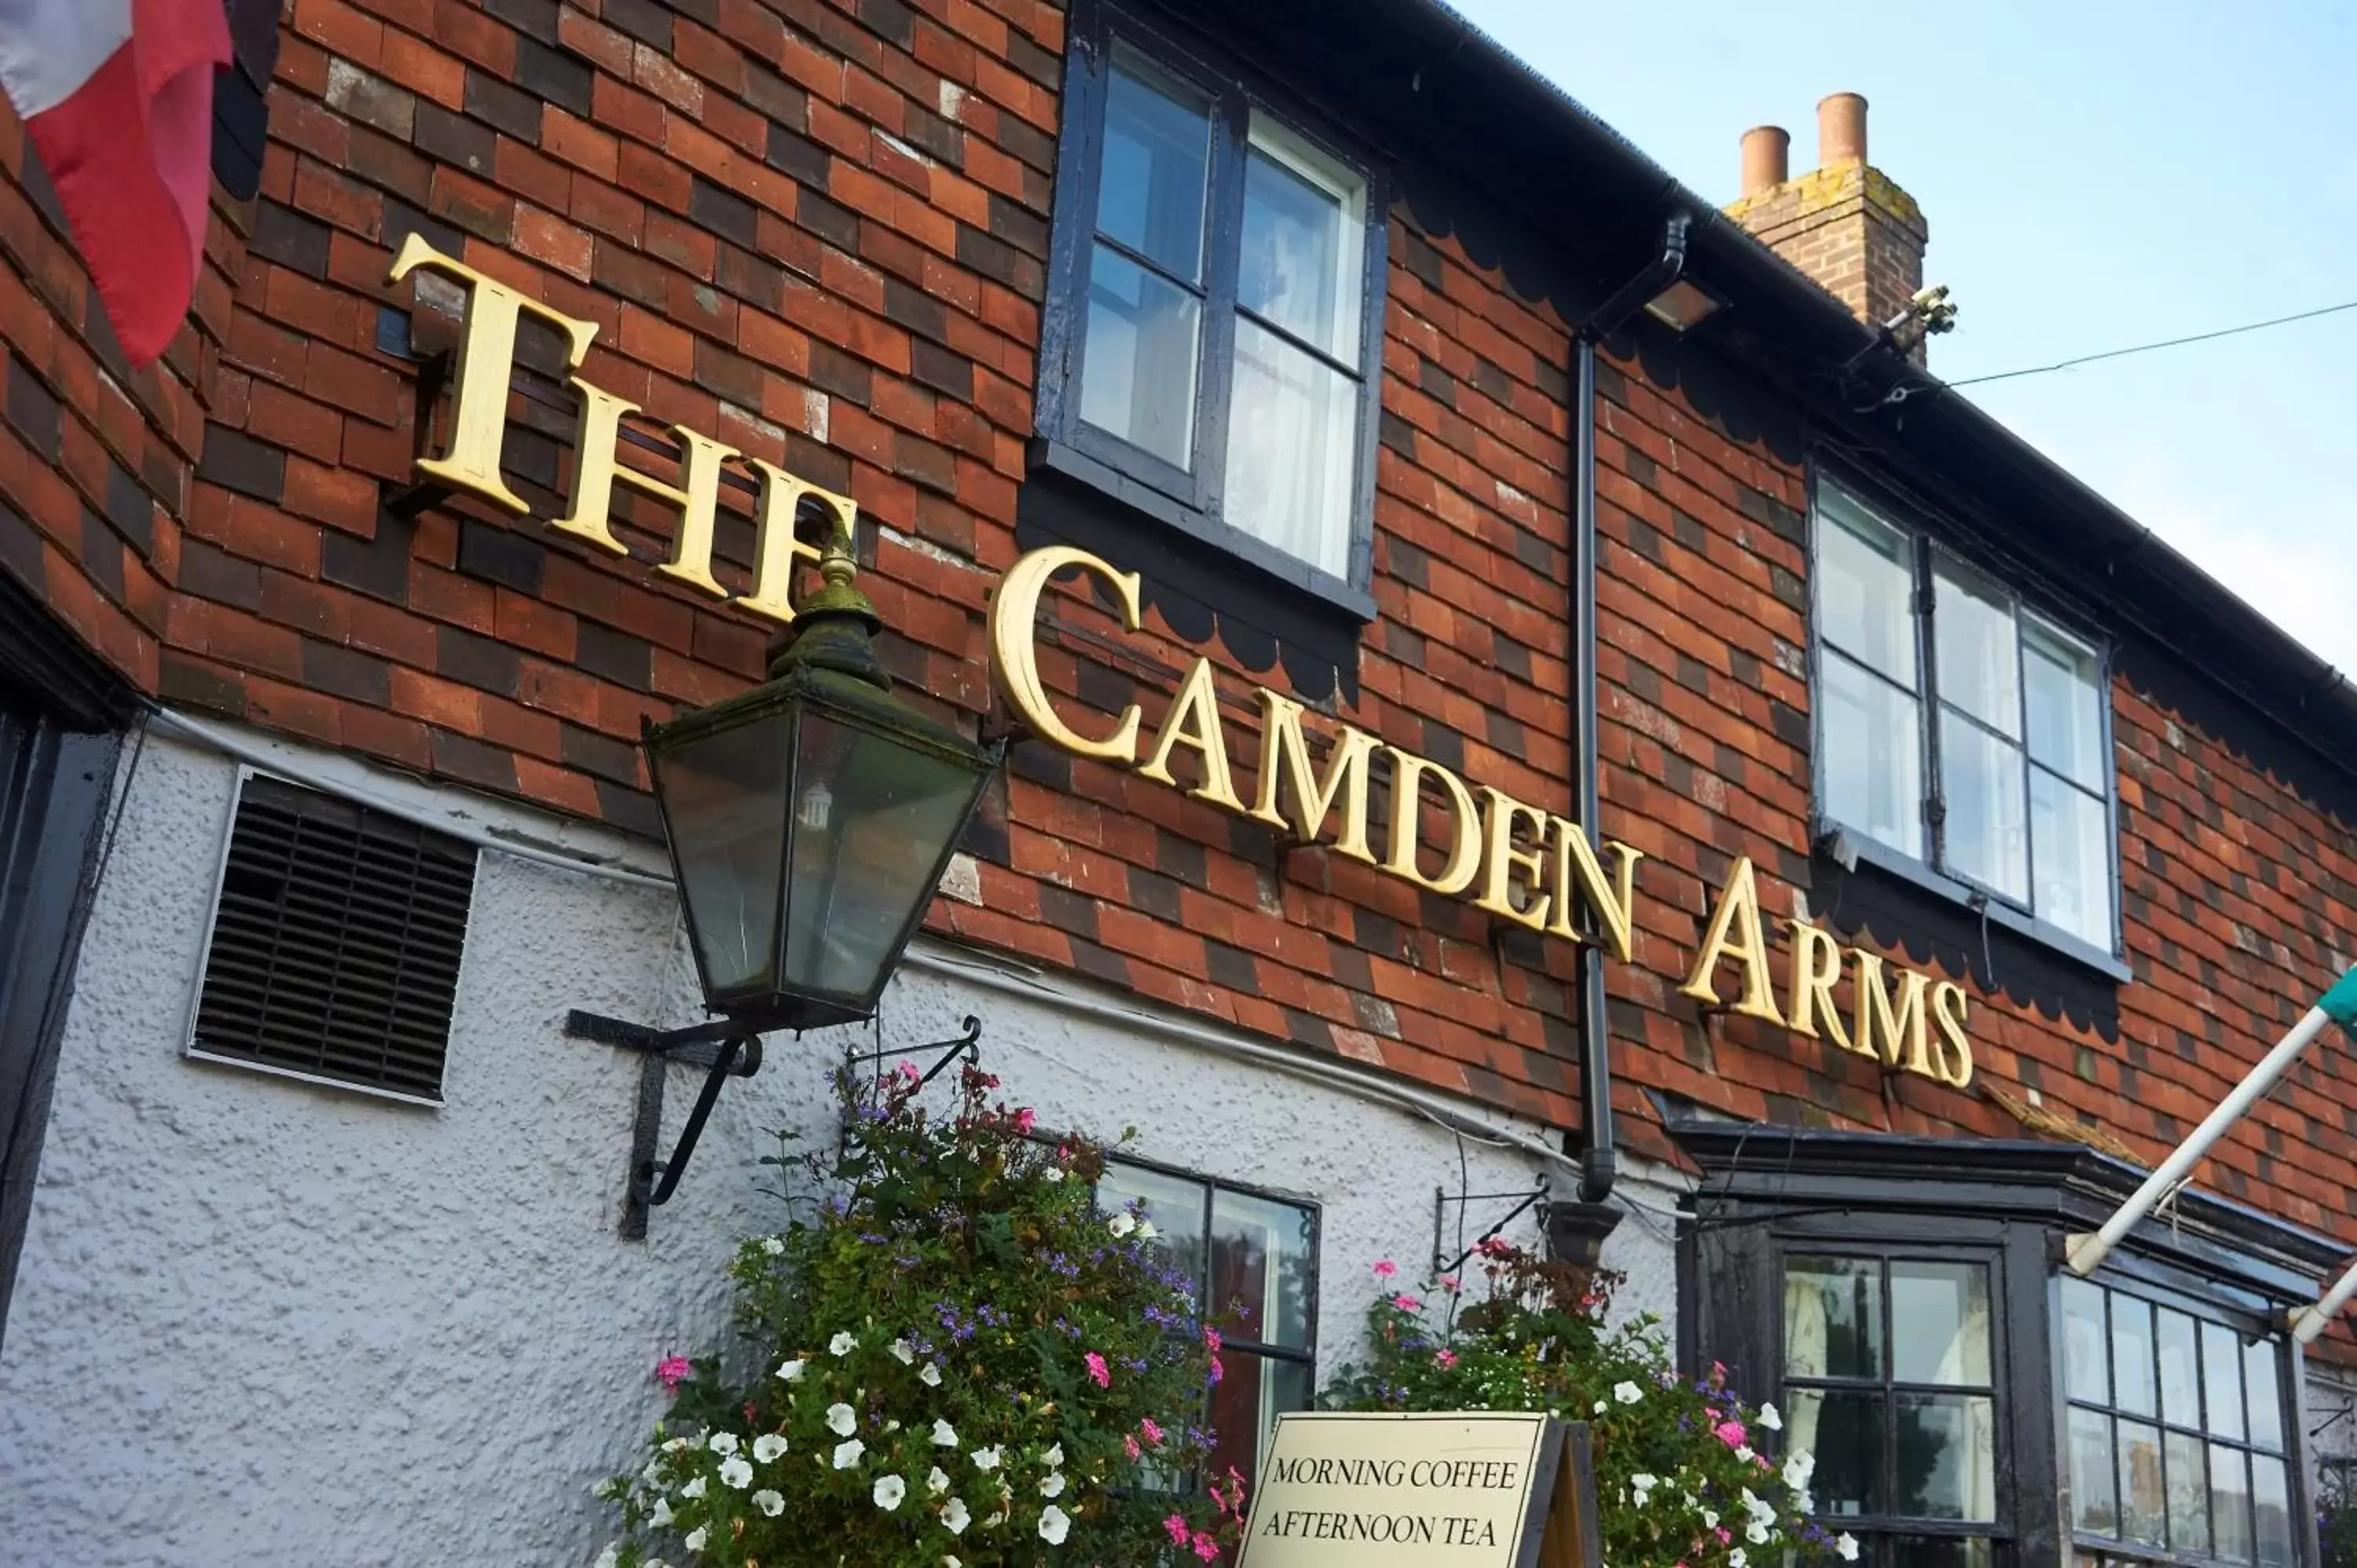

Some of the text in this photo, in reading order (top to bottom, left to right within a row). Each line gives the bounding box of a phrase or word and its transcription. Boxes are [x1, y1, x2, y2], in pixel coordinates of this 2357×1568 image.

[386, 232, 1973, 1087] THE CAMDEN ARMS
[1273, 1457, 1518, 1489] MORNING COFFEE
[1263, 1511, 1496, 1546] AFTERNOON TEA
